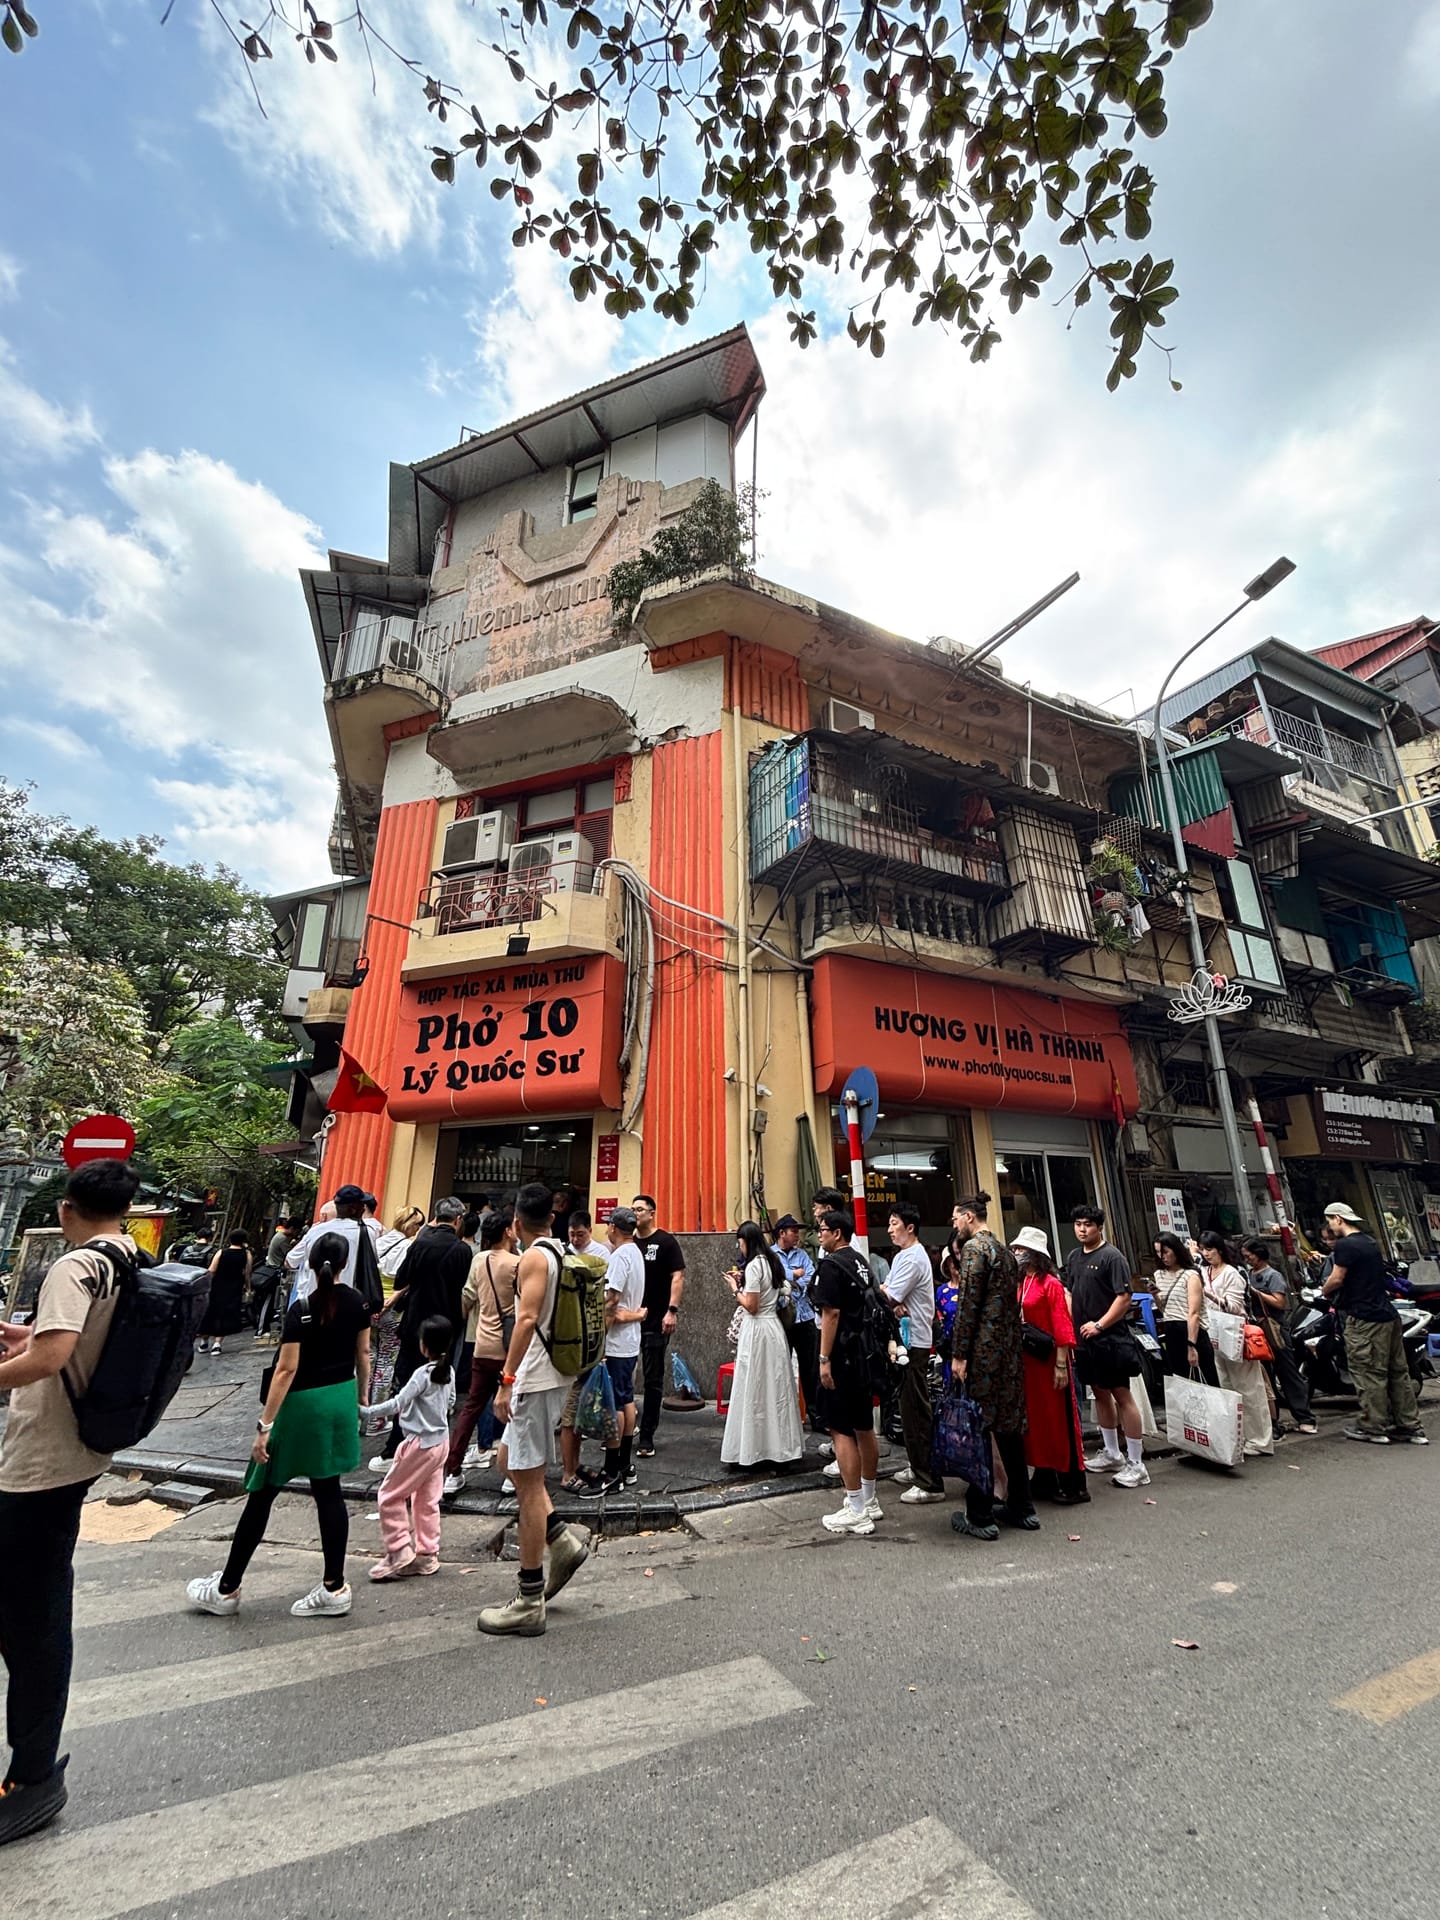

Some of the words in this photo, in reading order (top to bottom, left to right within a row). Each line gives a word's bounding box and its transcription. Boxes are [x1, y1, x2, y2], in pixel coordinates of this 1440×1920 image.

[417, 985, 447, 1006] HỢP
[512, 969, 550, 991] MÙA
[415, 1004, 503, 1053] Phở
[519, 997, 579, 1041] 10
[874, 1006, 967, 1043] HƯƠNG
[974, 1022, 1000, 1056] VỊ
[1005, 1023, 1034, 1053] HÀ
[1039, 1032, 1106, 1064] THÀNH
[401, 1062, 439, 1094] Lý
[445, 1049, 526, 1091] Quốc
[536, 1048, 585, 1077] Sư
[847, 1172, 885, 1188] OEN
